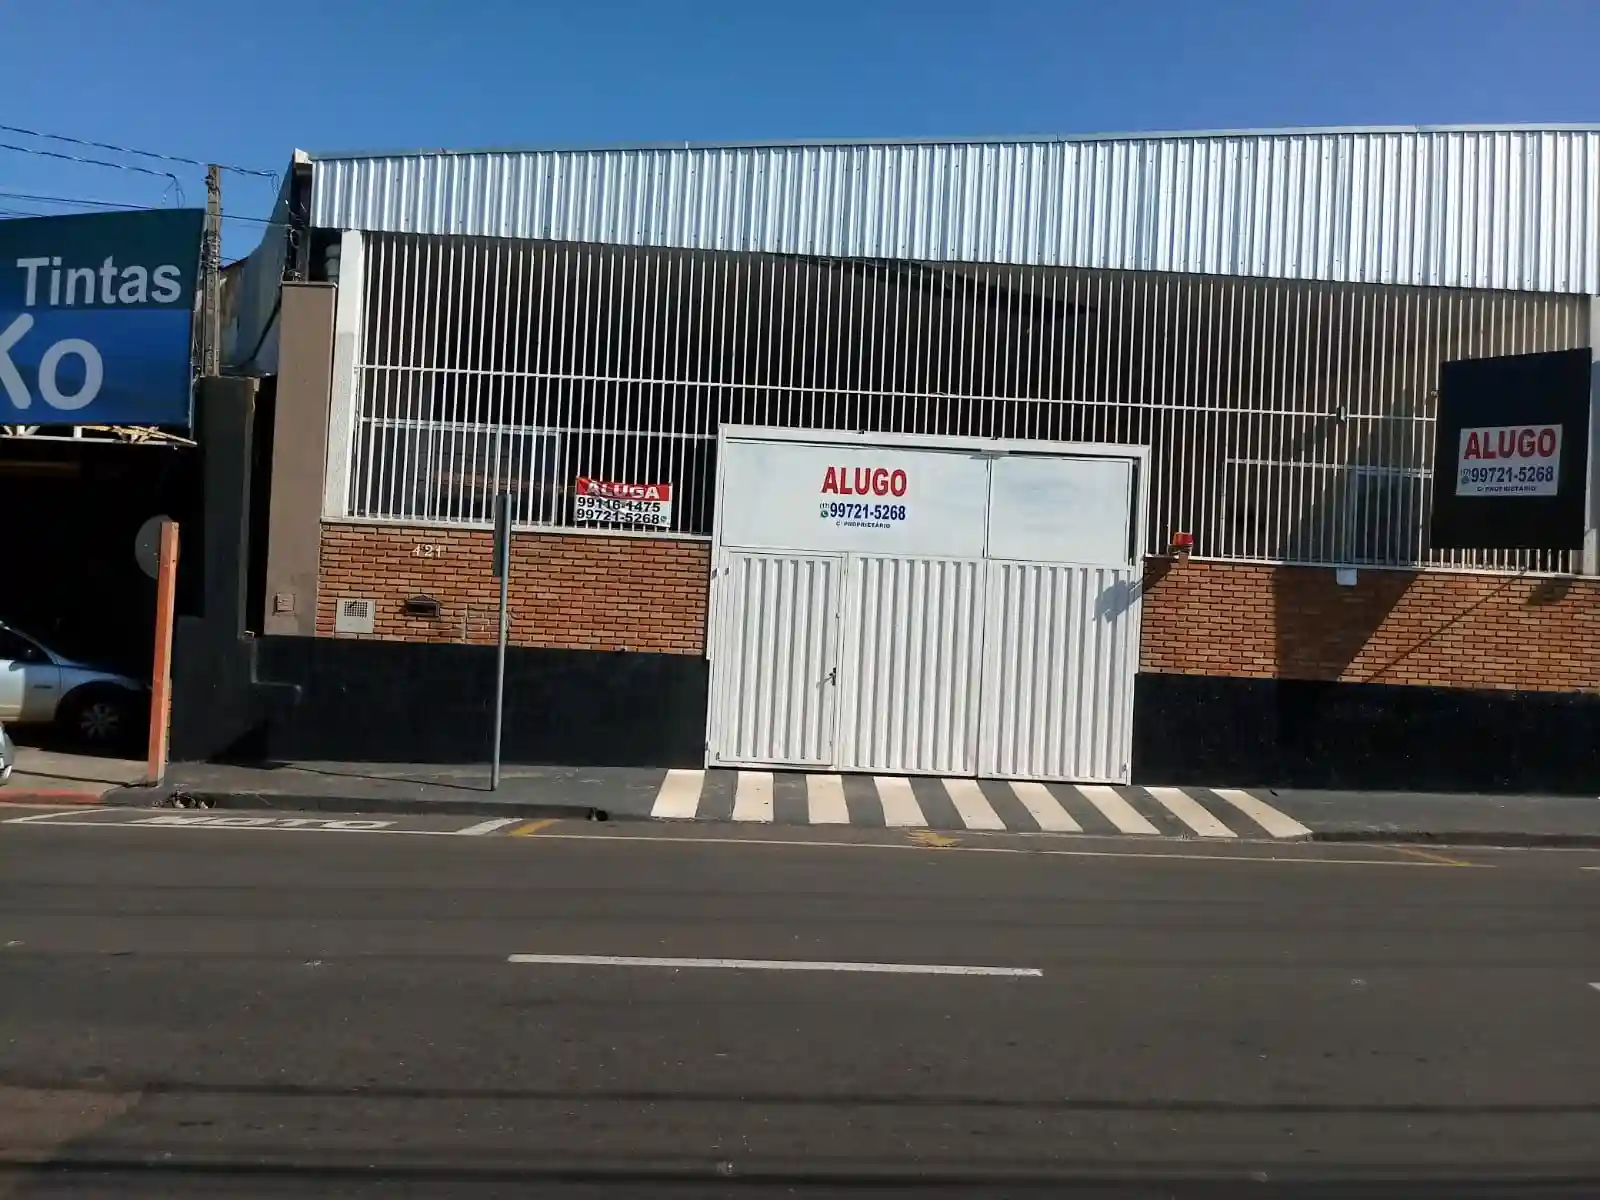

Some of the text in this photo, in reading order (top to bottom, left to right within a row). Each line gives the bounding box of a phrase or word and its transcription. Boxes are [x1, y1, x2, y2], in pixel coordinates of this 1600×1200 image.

[16, 255, 182, 307] Tintas
[1464, 427, 1557, 460] ALUGO
[821, 466, 907, 497] ALUGO
[1471, 466, 1554, 483] 99721-5268
[586, 480, 660, 499] ALUGA
[576, 508, 660, 524] 99721-5268
[830, 502, 906, 521] 99721-5268
